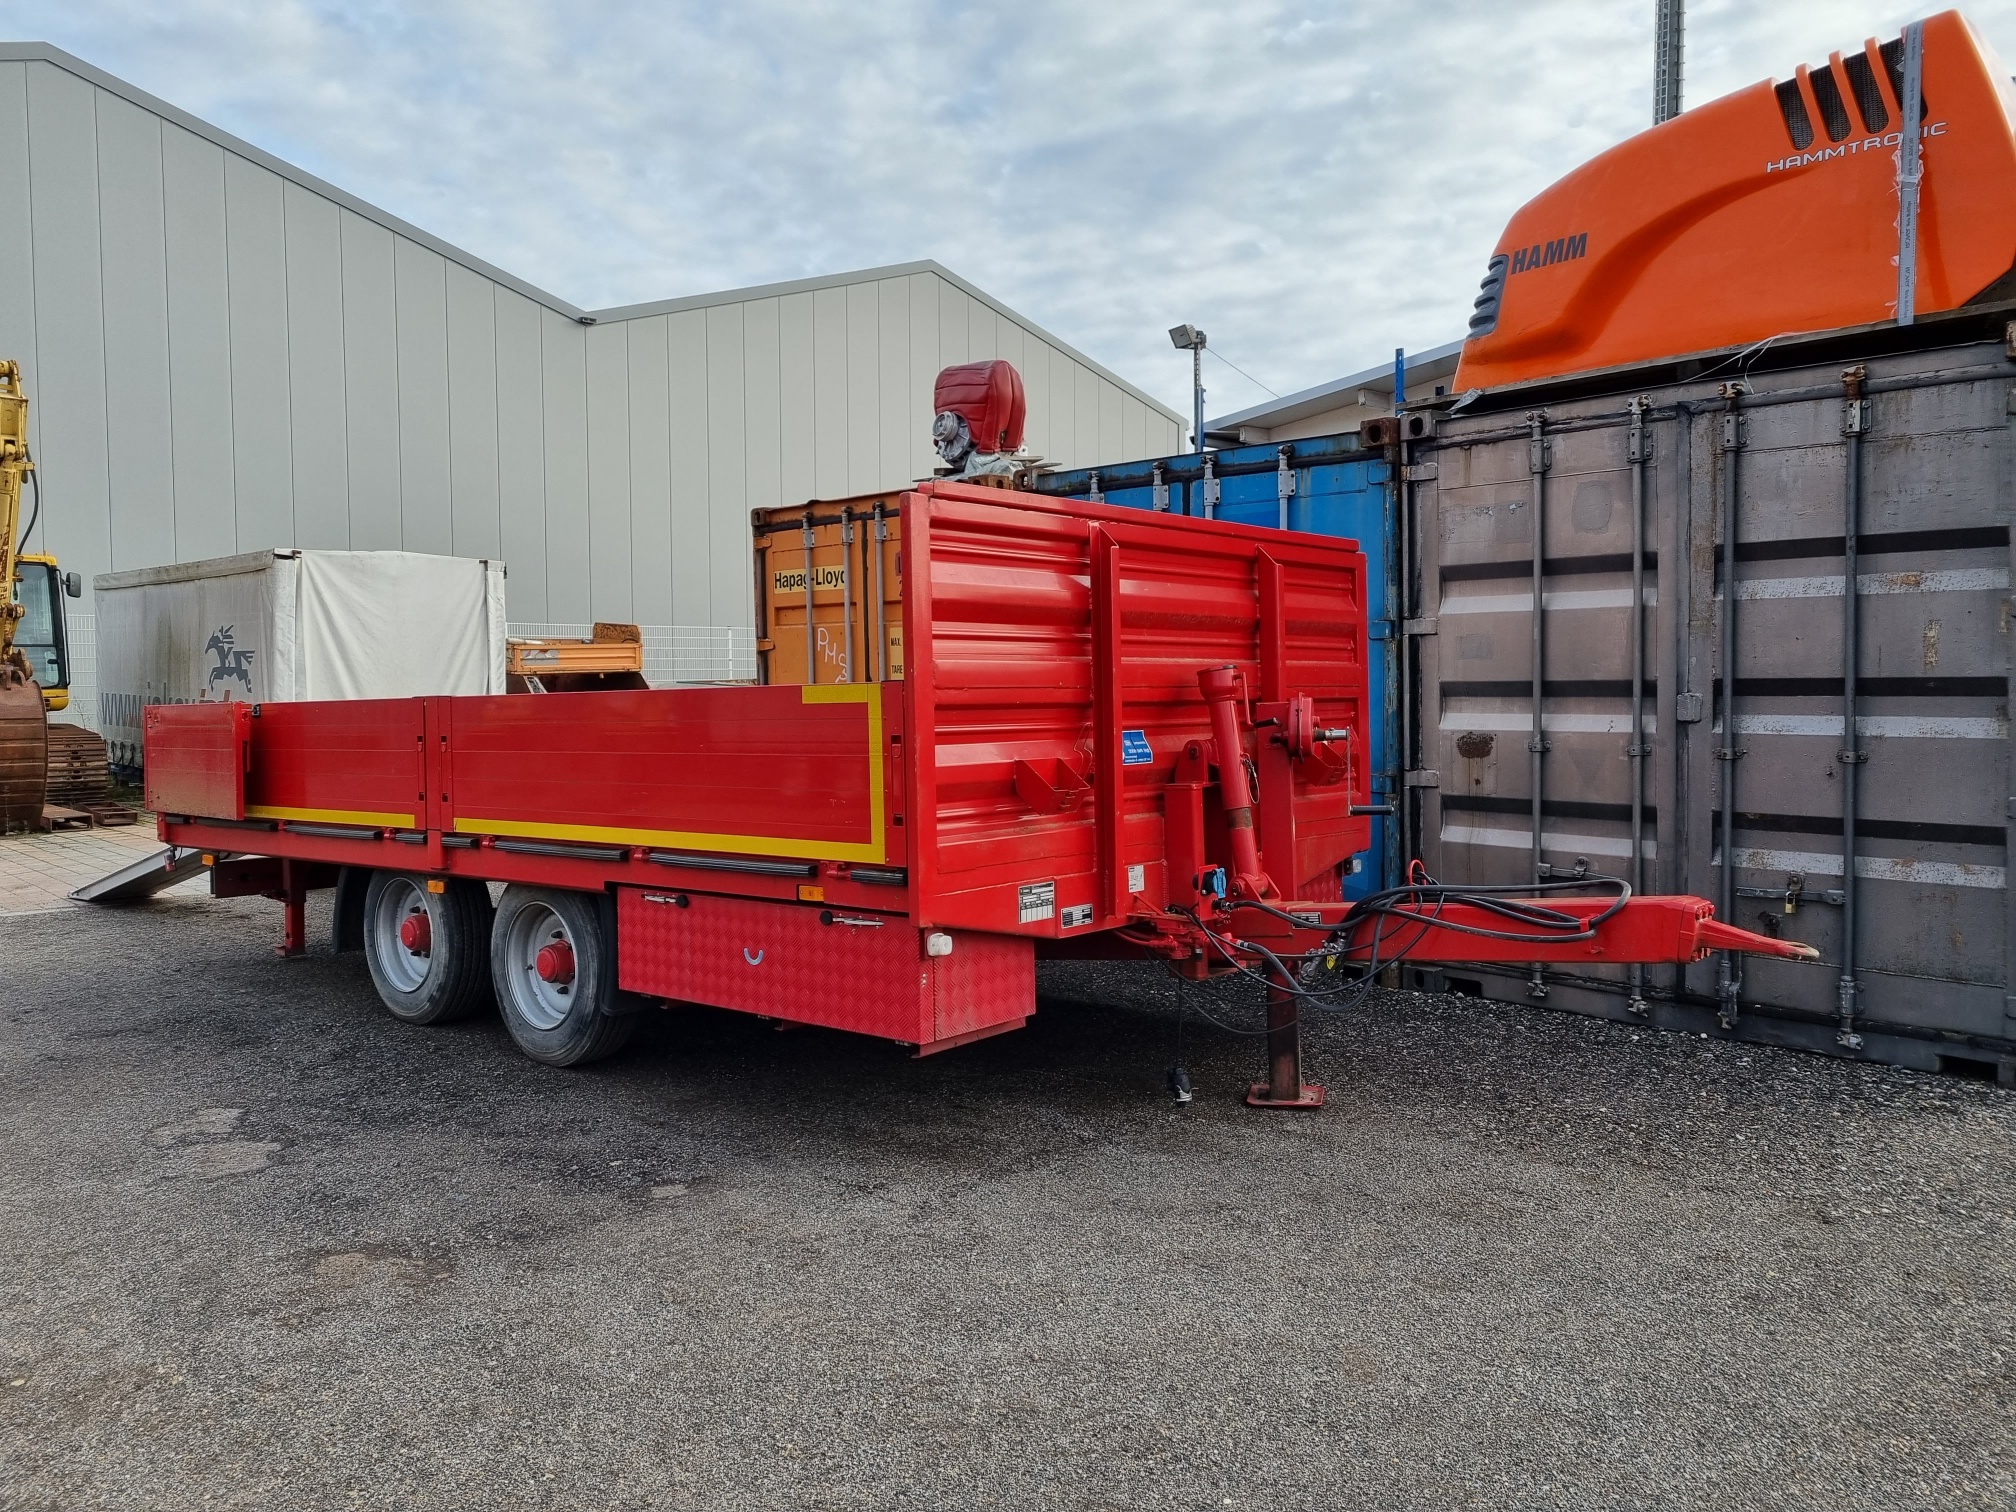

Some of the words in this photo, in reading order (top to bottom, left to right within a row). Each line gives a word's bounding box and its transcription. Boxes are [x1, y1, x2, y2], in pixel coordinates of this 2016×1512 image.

[1766, 121, 1948, 174] HAMMTROIC
[1510, 232, 1588, 275] HAMM
[891, 665, 903, 674] TARE
